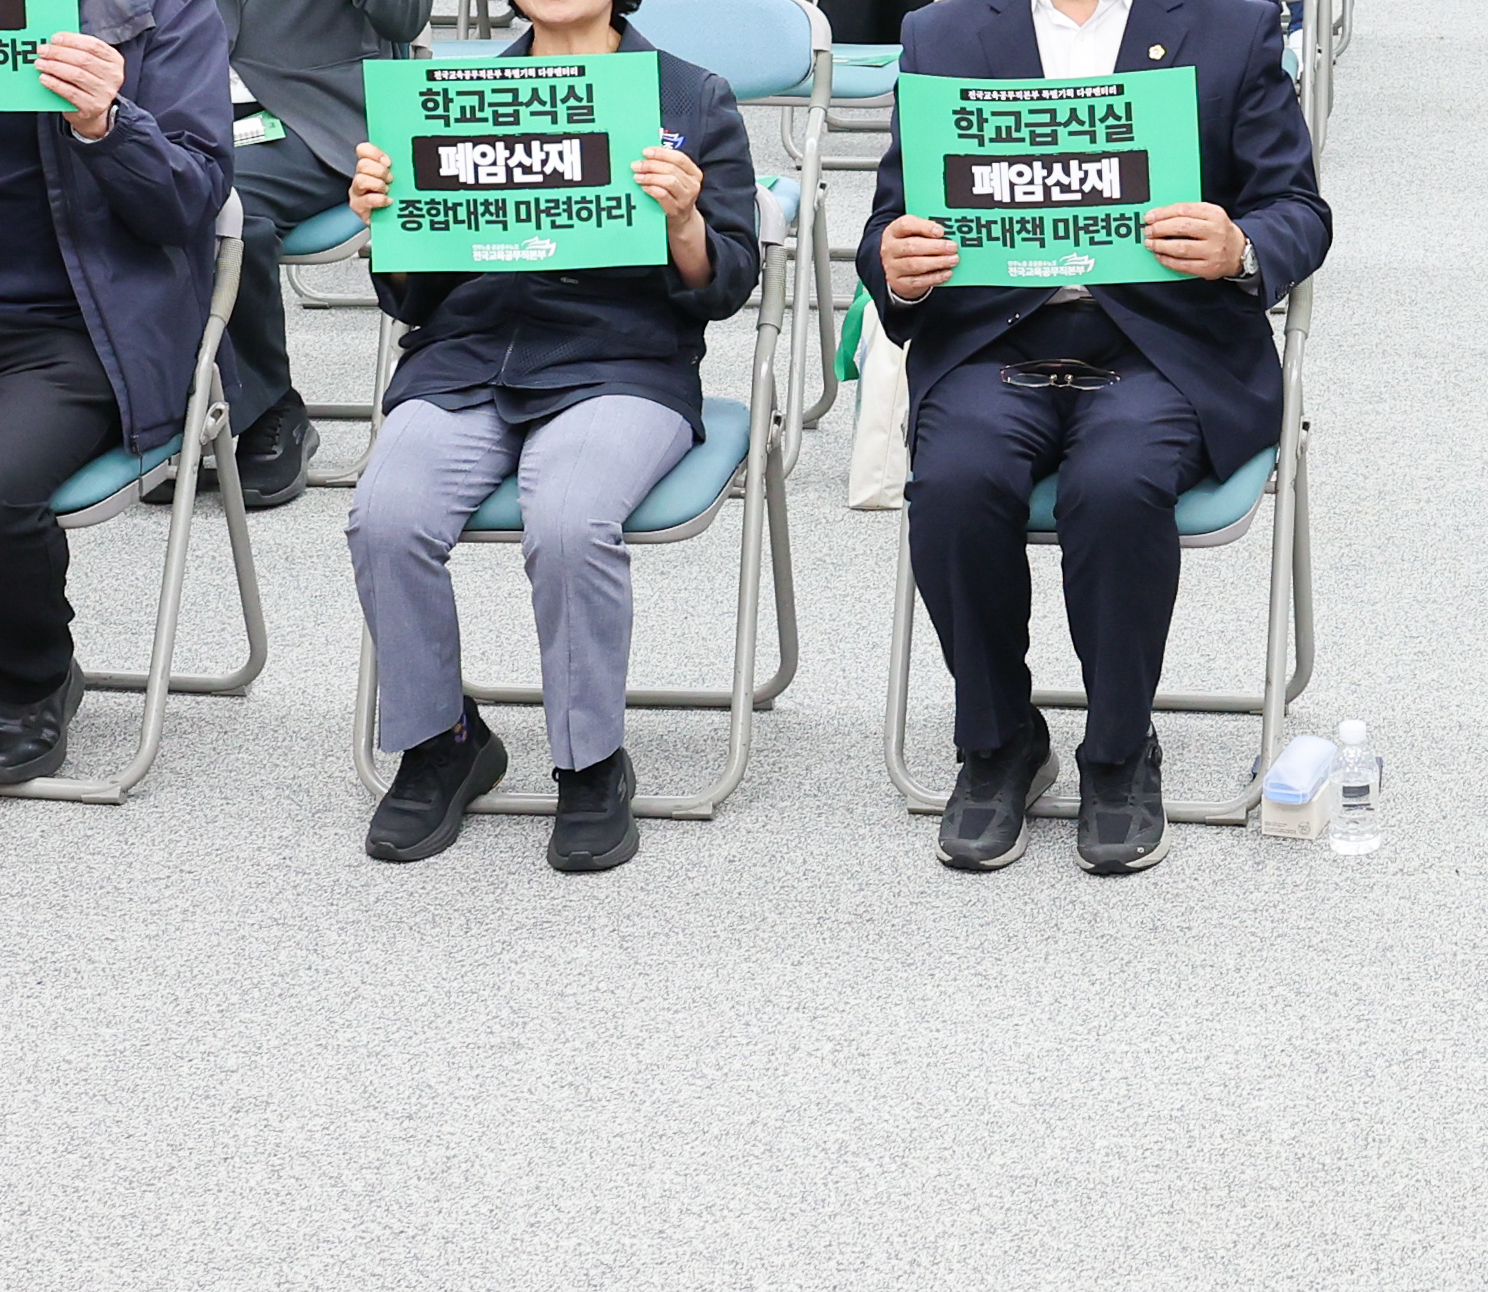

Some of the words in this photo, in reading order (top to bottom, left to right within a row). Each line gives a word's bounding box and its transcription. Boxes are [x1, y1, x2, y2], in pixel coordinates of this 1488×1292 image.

[503, 67, 535, 78] 특별기획
[418, 82, 594, 128] 학교급식실
[1041, 88, 1074, 98] 특별기획
[950, 103, 1134, 147] 학교급식실
[438, 139, 581, 183] 폐암산재
[972, 158, 1120, 202] 폐암산재
[394, 197, 508, 231] 종합대책
[515, 194, 636, 229] 마련하라
[1052, 213, 1147, 247] 마련하
